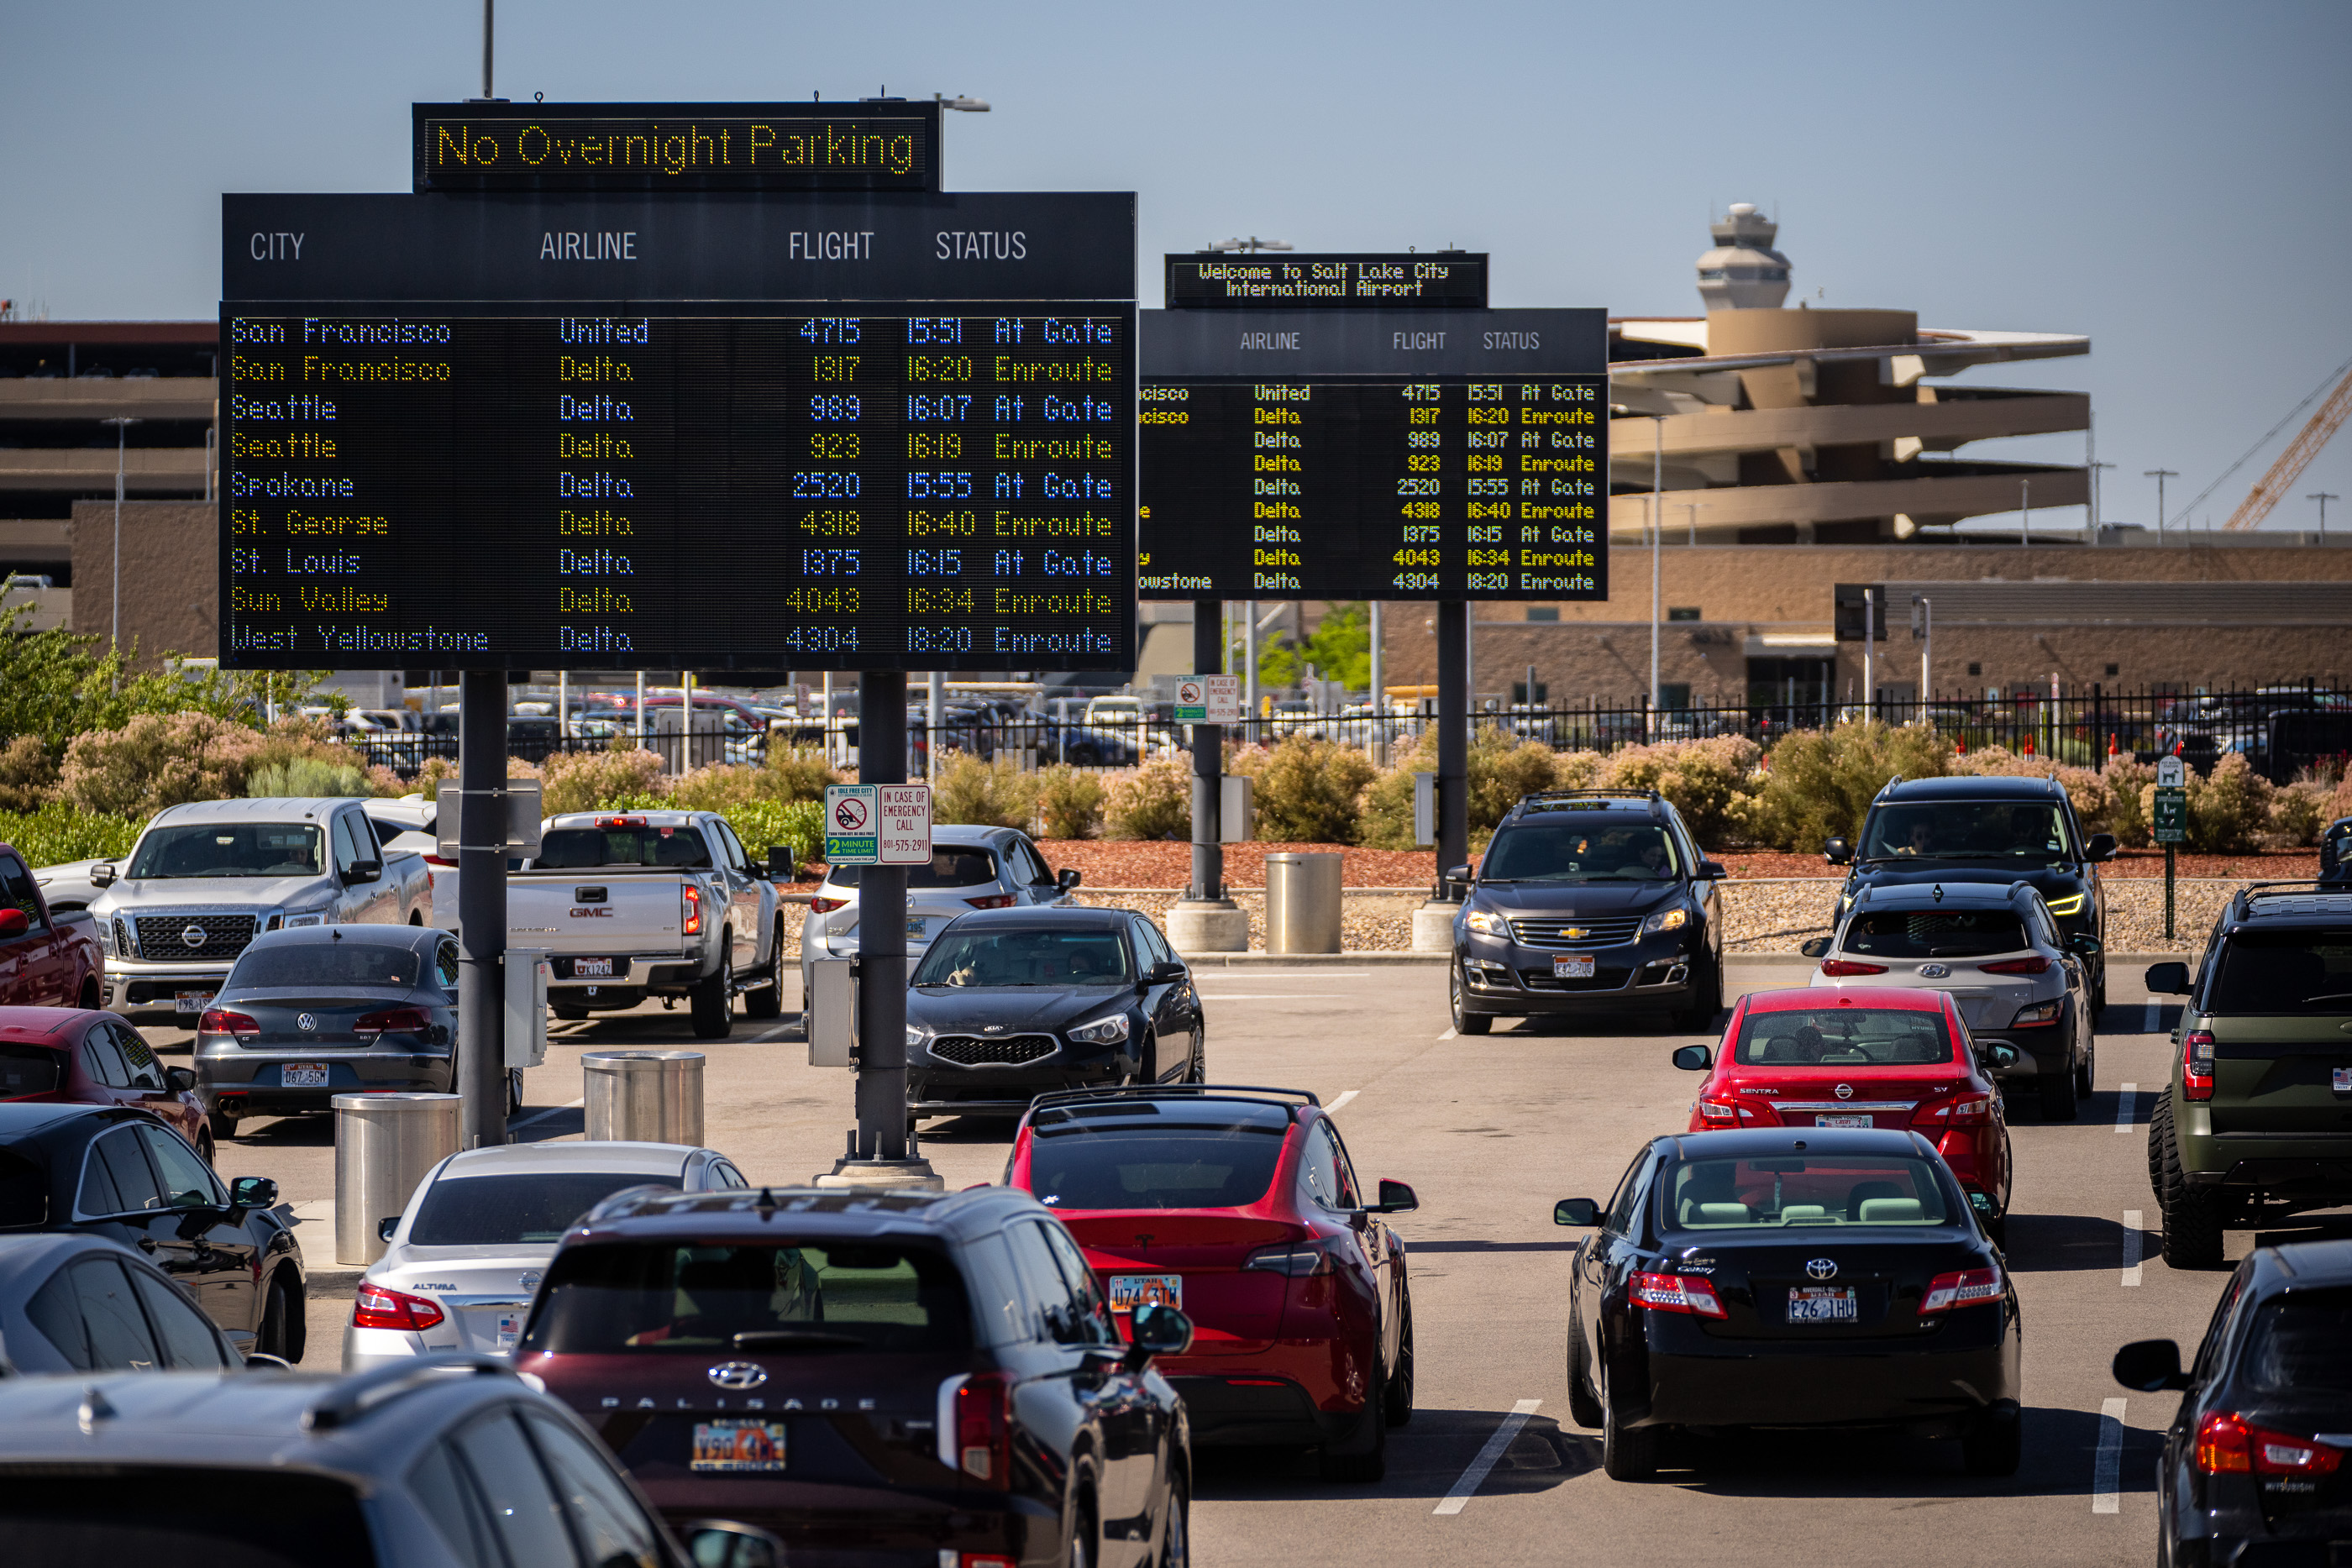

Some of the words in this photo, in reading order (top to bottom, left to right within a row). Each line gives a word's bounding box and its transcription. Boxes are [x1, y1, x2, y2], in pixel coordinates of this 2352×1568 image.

[439, 126, 498, 165] No
[519, 125, 730, 175] Overnight
[752, 125, 911, 174] Parking
[251, 233, 304, 260] CITY
[540, 233, 637, 260] AIRLINE
[790, 232, 874, 260] FLIGHT
[937, 232, 1026, 260] STATUS
[1200, 265, 1271, 279] Welcome
[1283, 265, 1301, 279] to
[1312, 265, 1348, 279] Salt
[1359, 265, 1404, 279] Lake
[1415, 265, 1448, 279] City
[1227, 280, 1346, 296] International
[1357, 280, 1423, 296] Airport
[233, 319, 284, 343] San
[305, 319, 450, 343] Francisco
[561, 319, 648, 343] United
[801, 319, 860, 343] 4715
[908, 319, 961, 343] 15:51
[995, 319, 1024, 343] At
[1044, 319, 1111, 343] Gate
[1241, 333, 1300, 349] AIRLINE
[1394, 333, 1446, 349] FLIGHT
[1483, 332, 1539, 349] STATUS
[233, 356, 284, 380] San
[305, 356, 449, 380] Francisco
[561, 356, 633, 380] Delta
[815, 356, 859, 380] 1317
[909, 356, 971, 380] 16:20
[996, 356, 1110, 380] Enroute
[1255, 385, 1310, 401] United
[1402, 385, 1440, 401] 4715
[1468, 385, 1502, 401] 15:51
[1522, 385, 1541, 401] At
[1552, 385, 1594, 401] Gate
[233, 395, 336, 420] Seattle
[561, 395, 633, 421] Delta
[811, 395, 860, 421] 989
[908, 395, 972, 421] 16:07
[995, 395, 1024, 421] At
[1044, 395, 1111, 421] Gate
[1255, 408, 1301, 424] Delta
[1410, 408, 1441, 424] 1317
[1468, 408, 1509, 424] 16:20
[1522, 408, 1594, 424] Enroute
[233, 433, 335, 457] Seattle
[561, 433, 633, 458] Delta
[811, 433, 859, 458] 923
[909, 433, 960, 458] 16:19
[996, 433, 1110, 458] Enroute
[1255, 432, 1301, 448] Delta
[1409, 432, 1440, 448] 989
[1468, 432, 1509, 448] 16:07
[1522, 432, 1541, 448] At
[1552, 432, 1594, 448] Gate
[1255, 455, 1301, 471] Delta
[1409, 455, 1440, 471] 923
[1468, 455, 1502, 471] 16:19
[1522, 455, 1594, 471] Enroute
[232, 471, 353, 497] Spokane
[561, 472, 633, 498] Delta
[794, 472, 860, 498] 2520
[908, 472, 972, 498] 15:55
[995, 472, 1024, 498] At
[1044, 472, 1111, 499] Gate
[1255, 479, 1301, 495] Delta
[1398, 479, 1440, 495] 2520
[1468, 479, 1508, 495] 15:55
[1522, 479, 1541, 495] At
[1551, 479, 1593, 496] Gate
[1255, 502, 1301, 518] Delta
[1402, 502, 1440, 518] 4318
[1468, 502, 1510, 518] 16:40
[1521, 502, 1594, 518] Enroute
[233, 510, 266, 533] St.
[288, 510, 387, 534] George
[561, 511, 633, 534] Delta
[801, 511, 859, 535] 4318
[909, 511, 974, 535] 16:40
[996, 511, 1110, 535] Enroute
[1255, 526, 1301, 542] Delta
[1404, 526, 1440, 543] 1375
[1467, 526, 1502, 543] 16:15
[1521, 526, 1540, 542] At
[1551, 526, 1593, 543] Gate
[233, 548, 266, 574] St.
[287, 548, 360, 574] Louis
[561, 549, 633, 574] Delta
[804, 549, 859, 575] 1375
[908, 549, 961, 575] 16:15
[995, 549, 1023, 575] At
[1044, 550, 1110, 575] Gate
[1254, 549, 1301, 565] Delta
[1394, 549, 1440, 565] 4043
[1467, 549, 1510, 565] 16:34
[1521, 549, 1593, 566] Enroute
[1254, 573, 1301, 589] Delta
[1393, 573, 1440, 590] 4304
[1467, 573, 1508, 590] 18:20
[1521, 573, 1593, 590] Enroute
[233, 587, 280, 611] Sun
[302, 587, 386, 611] Valley
[561, 588, 633, 611] Delta
[787, 588, 858, 611] 4043
[909, 588, 974, 612] 16:34
[996, 588, 1110, 612] Enroute
[232, 625, 297, 649] West
[318, 626, 487, 651] Yellowstone
[561, 627, 633, 652] Delta
[787, 627, 859, 652] 4304
[908, 627, 971, 652] 18:20
[995, 627, 1110, 652] Enroute
[1177, 708, 1183, 717] 2
[884, 791, 891, 803] IN
[895, 791, 912, 803] CASE
[916, 791, 926, 803] OF
[884, 805, 926, 816] EMERGENCY
[896, 820, 914, 831] CALL
[829, 839, 840, 853] 2
[884, 840, 927, 851] 801-575-2911
[570, 908, 613, 917] GMC
[286, 1071, 302, 1083] D67
[308, 1071, 325, 1082] 5GM
[1116, 1287, 1140, 1305] U74
[1152, 1287, 1176, 1304] 3TW
[1791, 1300, 1818, 1317] E26
[1830, 1300, 1854, 1317] 1HU
[601, 1398, 875, 1409] PALISADE
